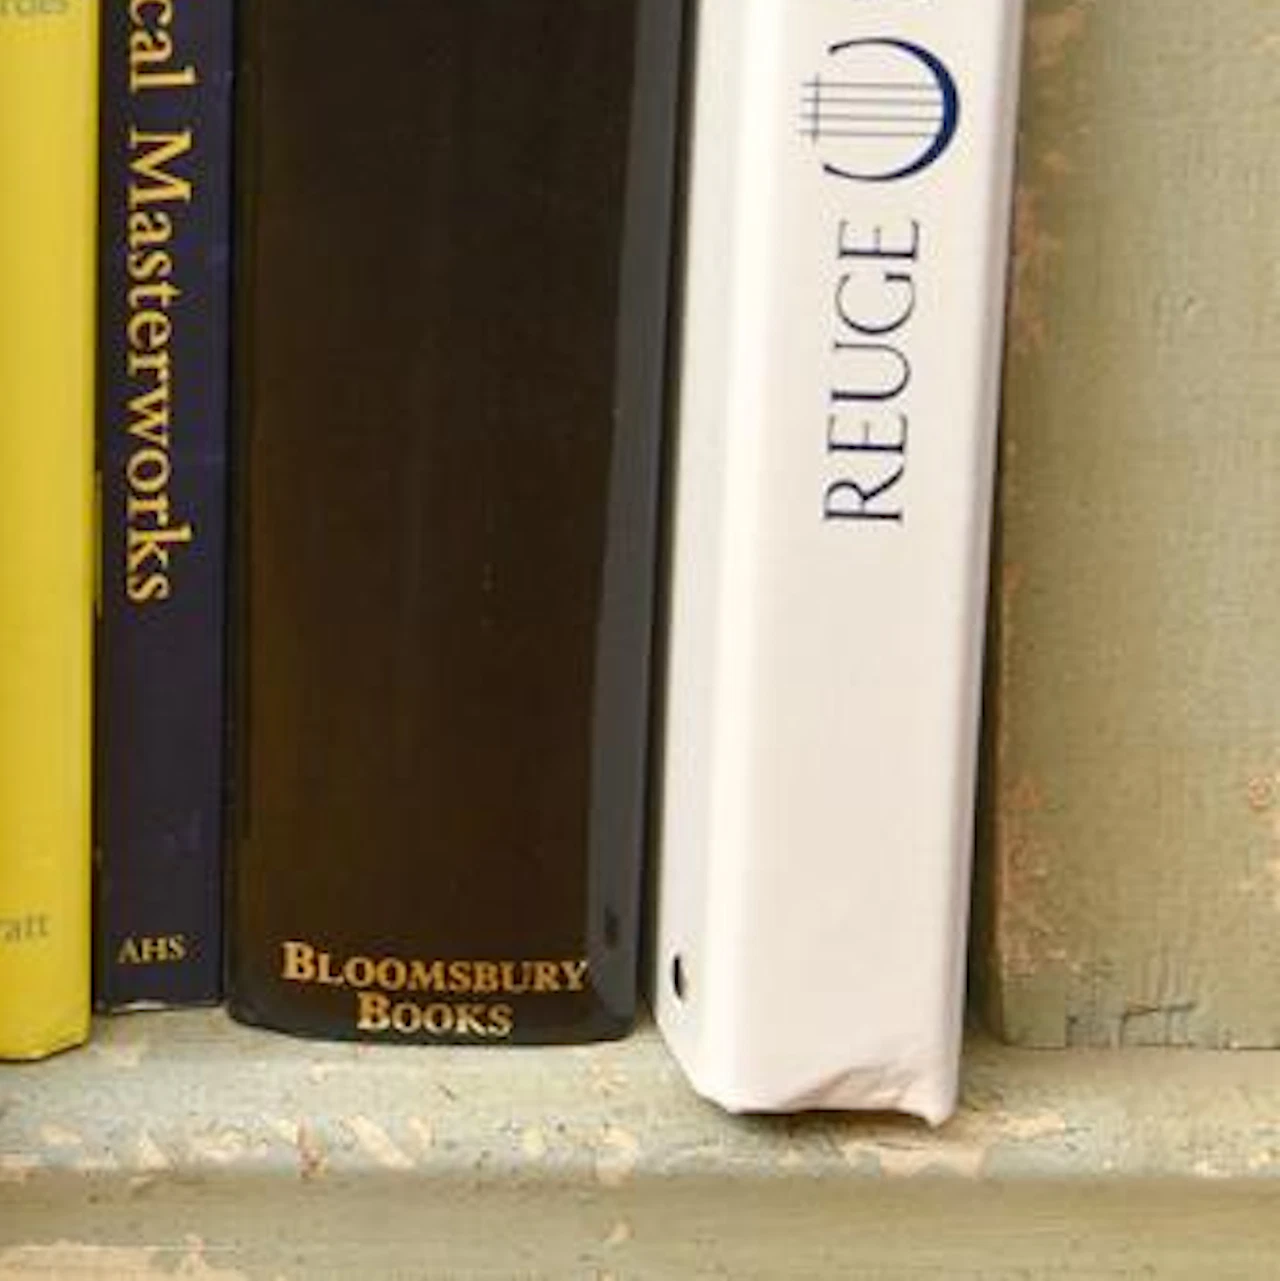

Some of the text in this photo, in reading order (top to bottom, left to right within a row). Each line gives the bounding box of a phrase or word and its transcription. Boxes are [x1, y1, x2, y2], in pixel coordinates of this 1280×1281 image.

[125, 127, 196, 607] Masterworks
[823, 217, 923, 524] REUGE
[117, 933, 187, 967] AHS
[280, 939, 589, 994] BLOOMSBURY
[355, 991, 516, 1037] BOOKS
